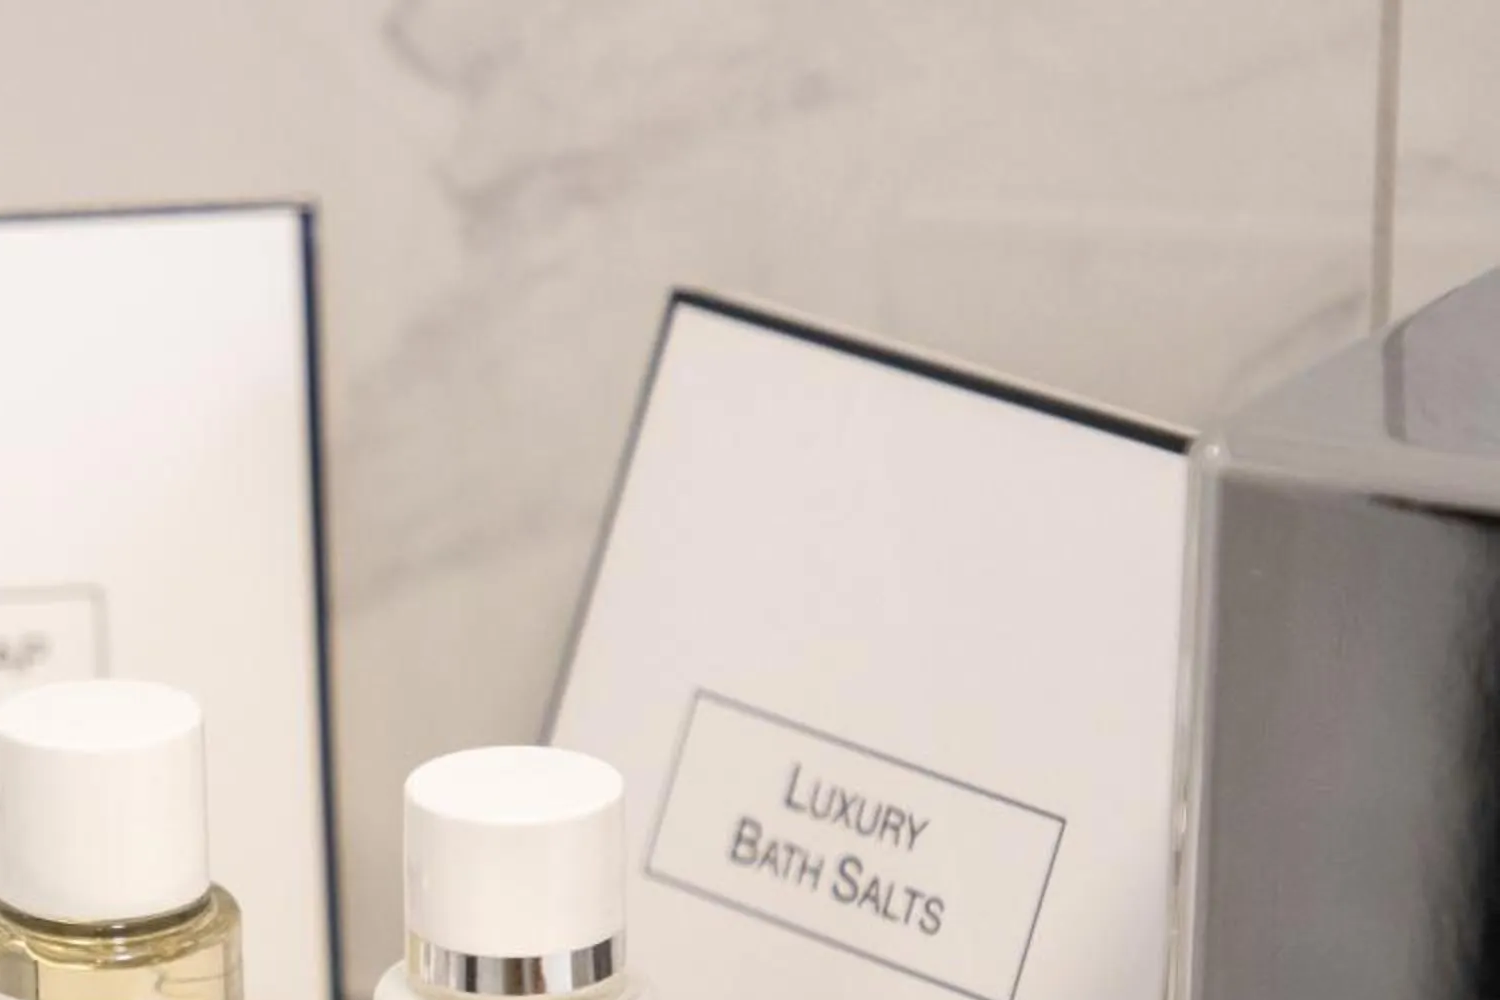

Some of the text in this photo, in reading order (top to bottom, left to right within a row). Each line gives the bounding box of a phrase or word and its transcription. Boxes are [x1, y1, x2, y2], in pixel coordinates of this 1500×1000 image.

[784, 762, 930, 852] LUXURY
[730, 815, 945, 936] BATH SALTS
